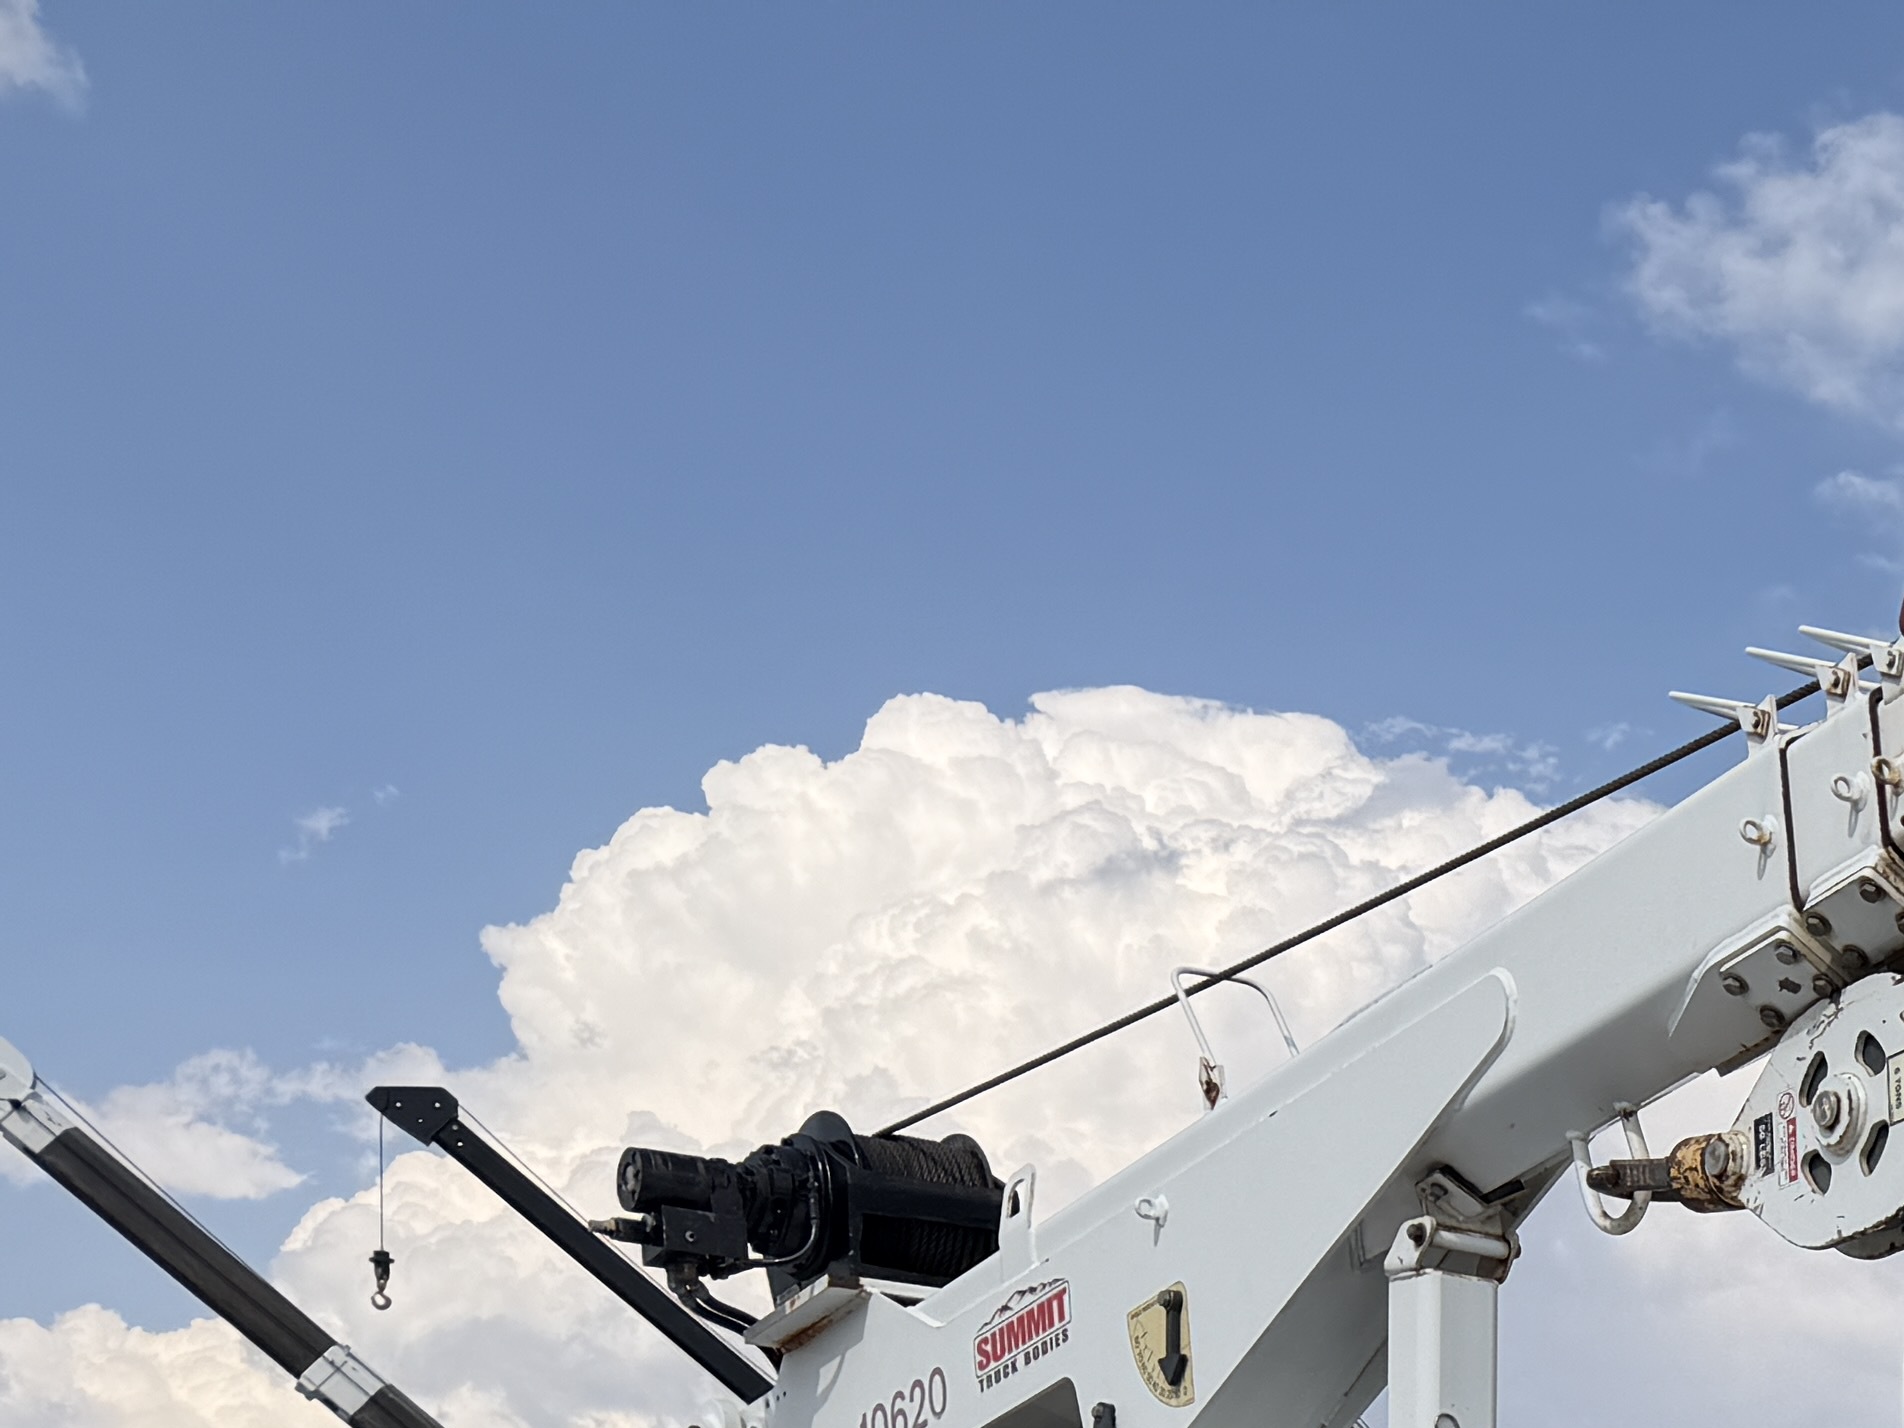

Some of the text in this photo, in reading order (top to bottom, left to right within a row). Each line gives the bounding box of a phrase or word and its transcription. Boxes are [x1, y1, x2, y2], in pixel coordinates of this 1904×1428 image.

[976, 1286, 1068, 1372] SUMMIT
[978, 1327, 1070, 1393] TRUCK BODIES
